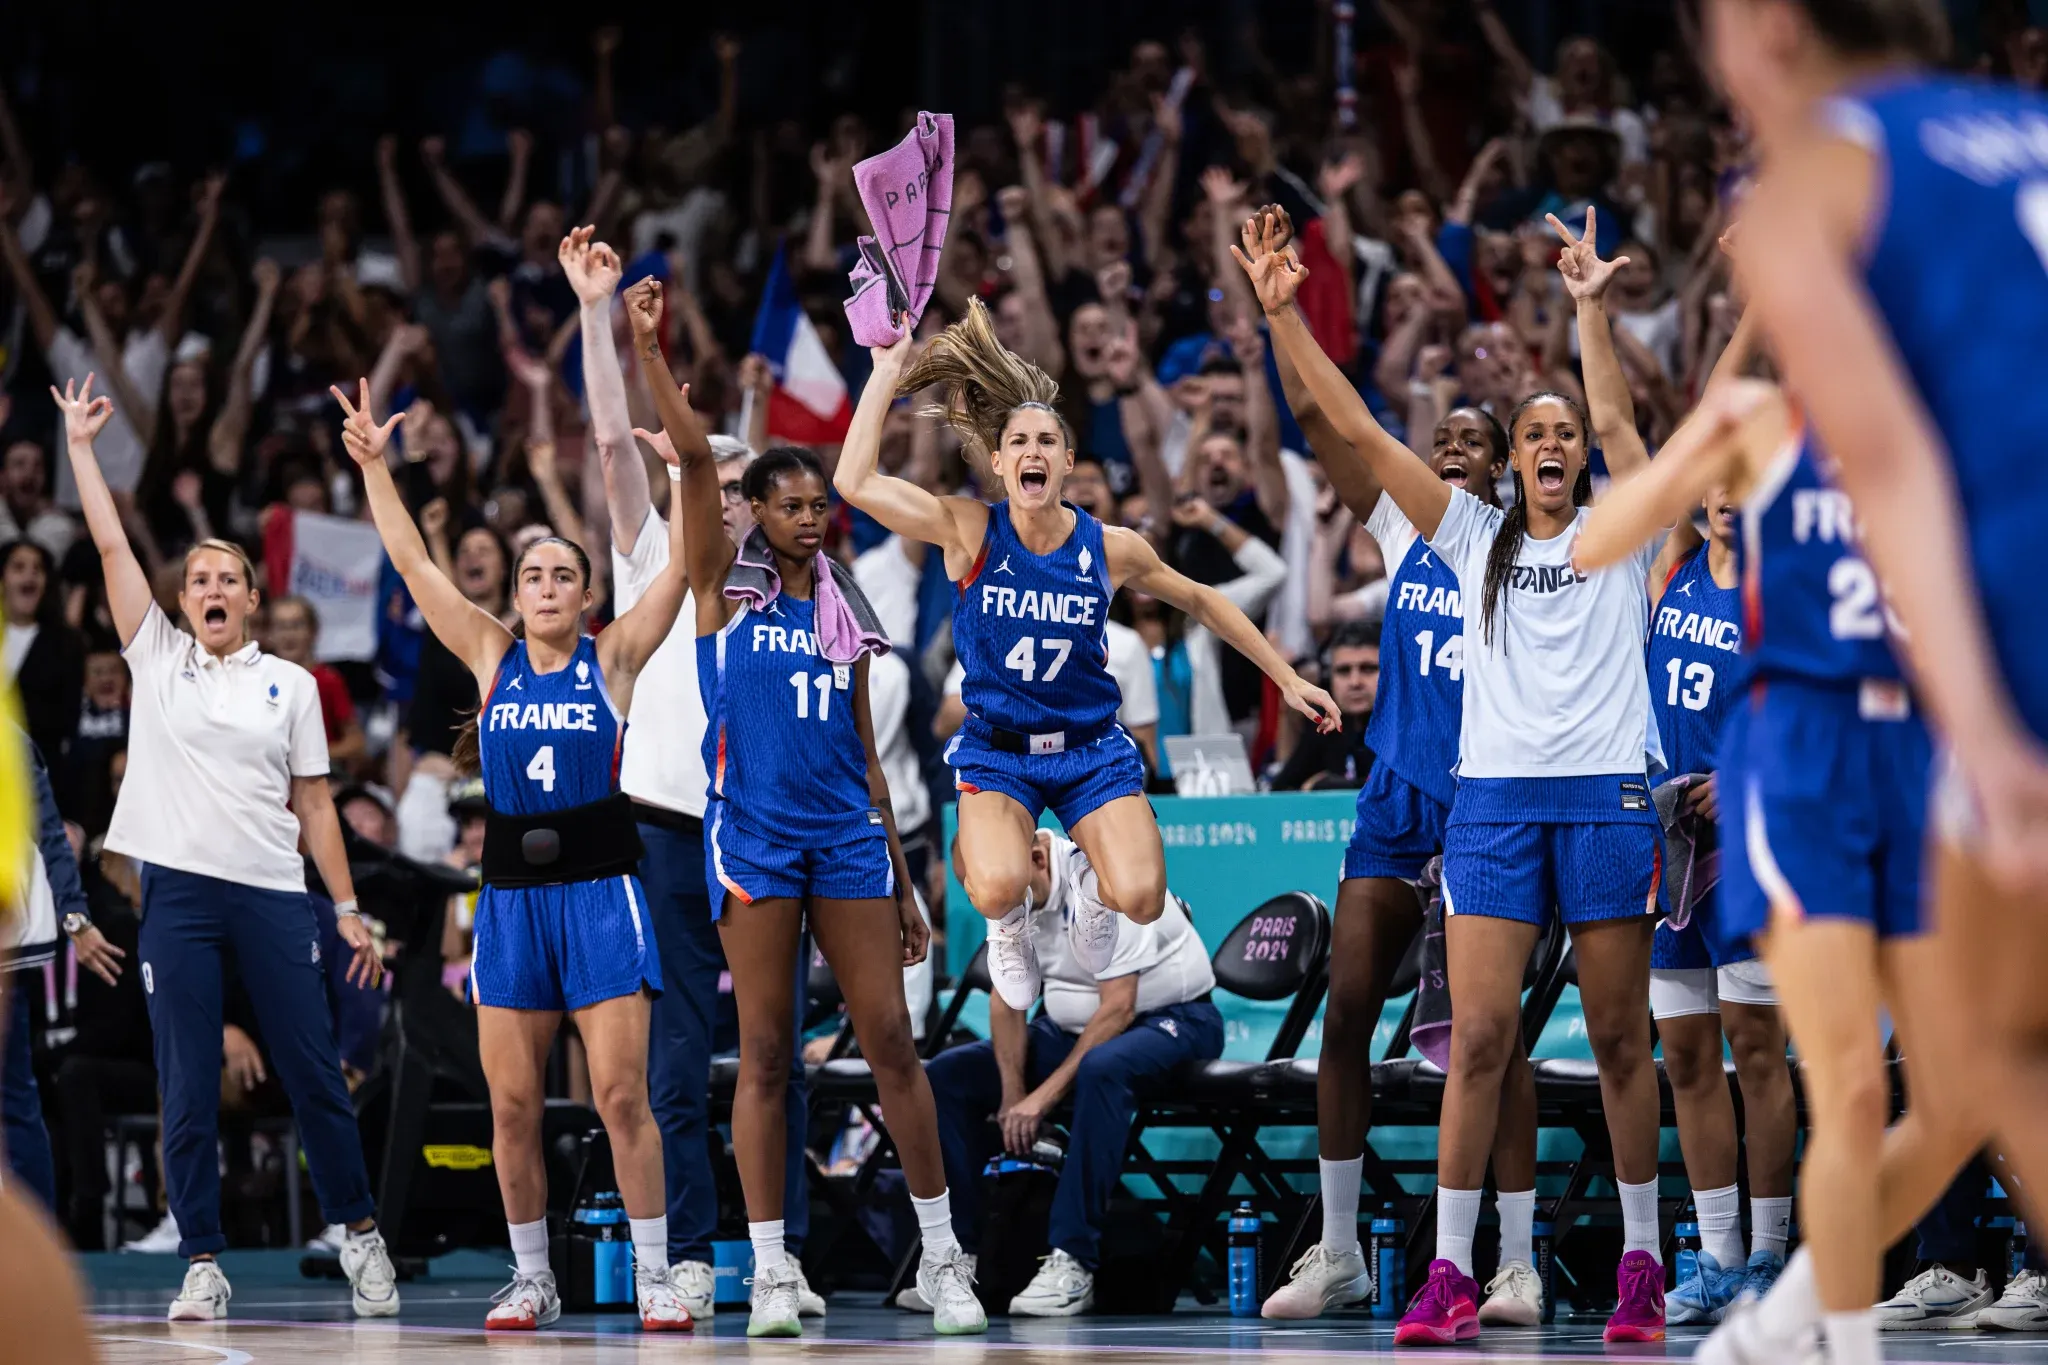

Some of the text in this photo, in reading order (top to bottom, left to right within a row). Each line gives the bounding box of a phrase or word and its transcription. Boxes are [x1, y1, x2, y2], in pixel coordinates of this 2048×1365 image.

[1505, 564, 1589, 594] RANCE
[982, 584, 1099, 626] FRANCE
[1005, 636, 1073, 682] 47
[1414, 630, 1463, 681] 14
[788, 671, 832, 721] 11
[1666, 657, 1715, 711] 13
[489, 702, 597, 732] FRANCE
[526, 745, 556, 792] 4
[1208, 821, 1257, 846] 2024
[1242, 940, 1289, 962] 2024
[1370, 1236, 1379, 1302] POWERADE
[1540, 1239, 1549, 1302] OWERADE
